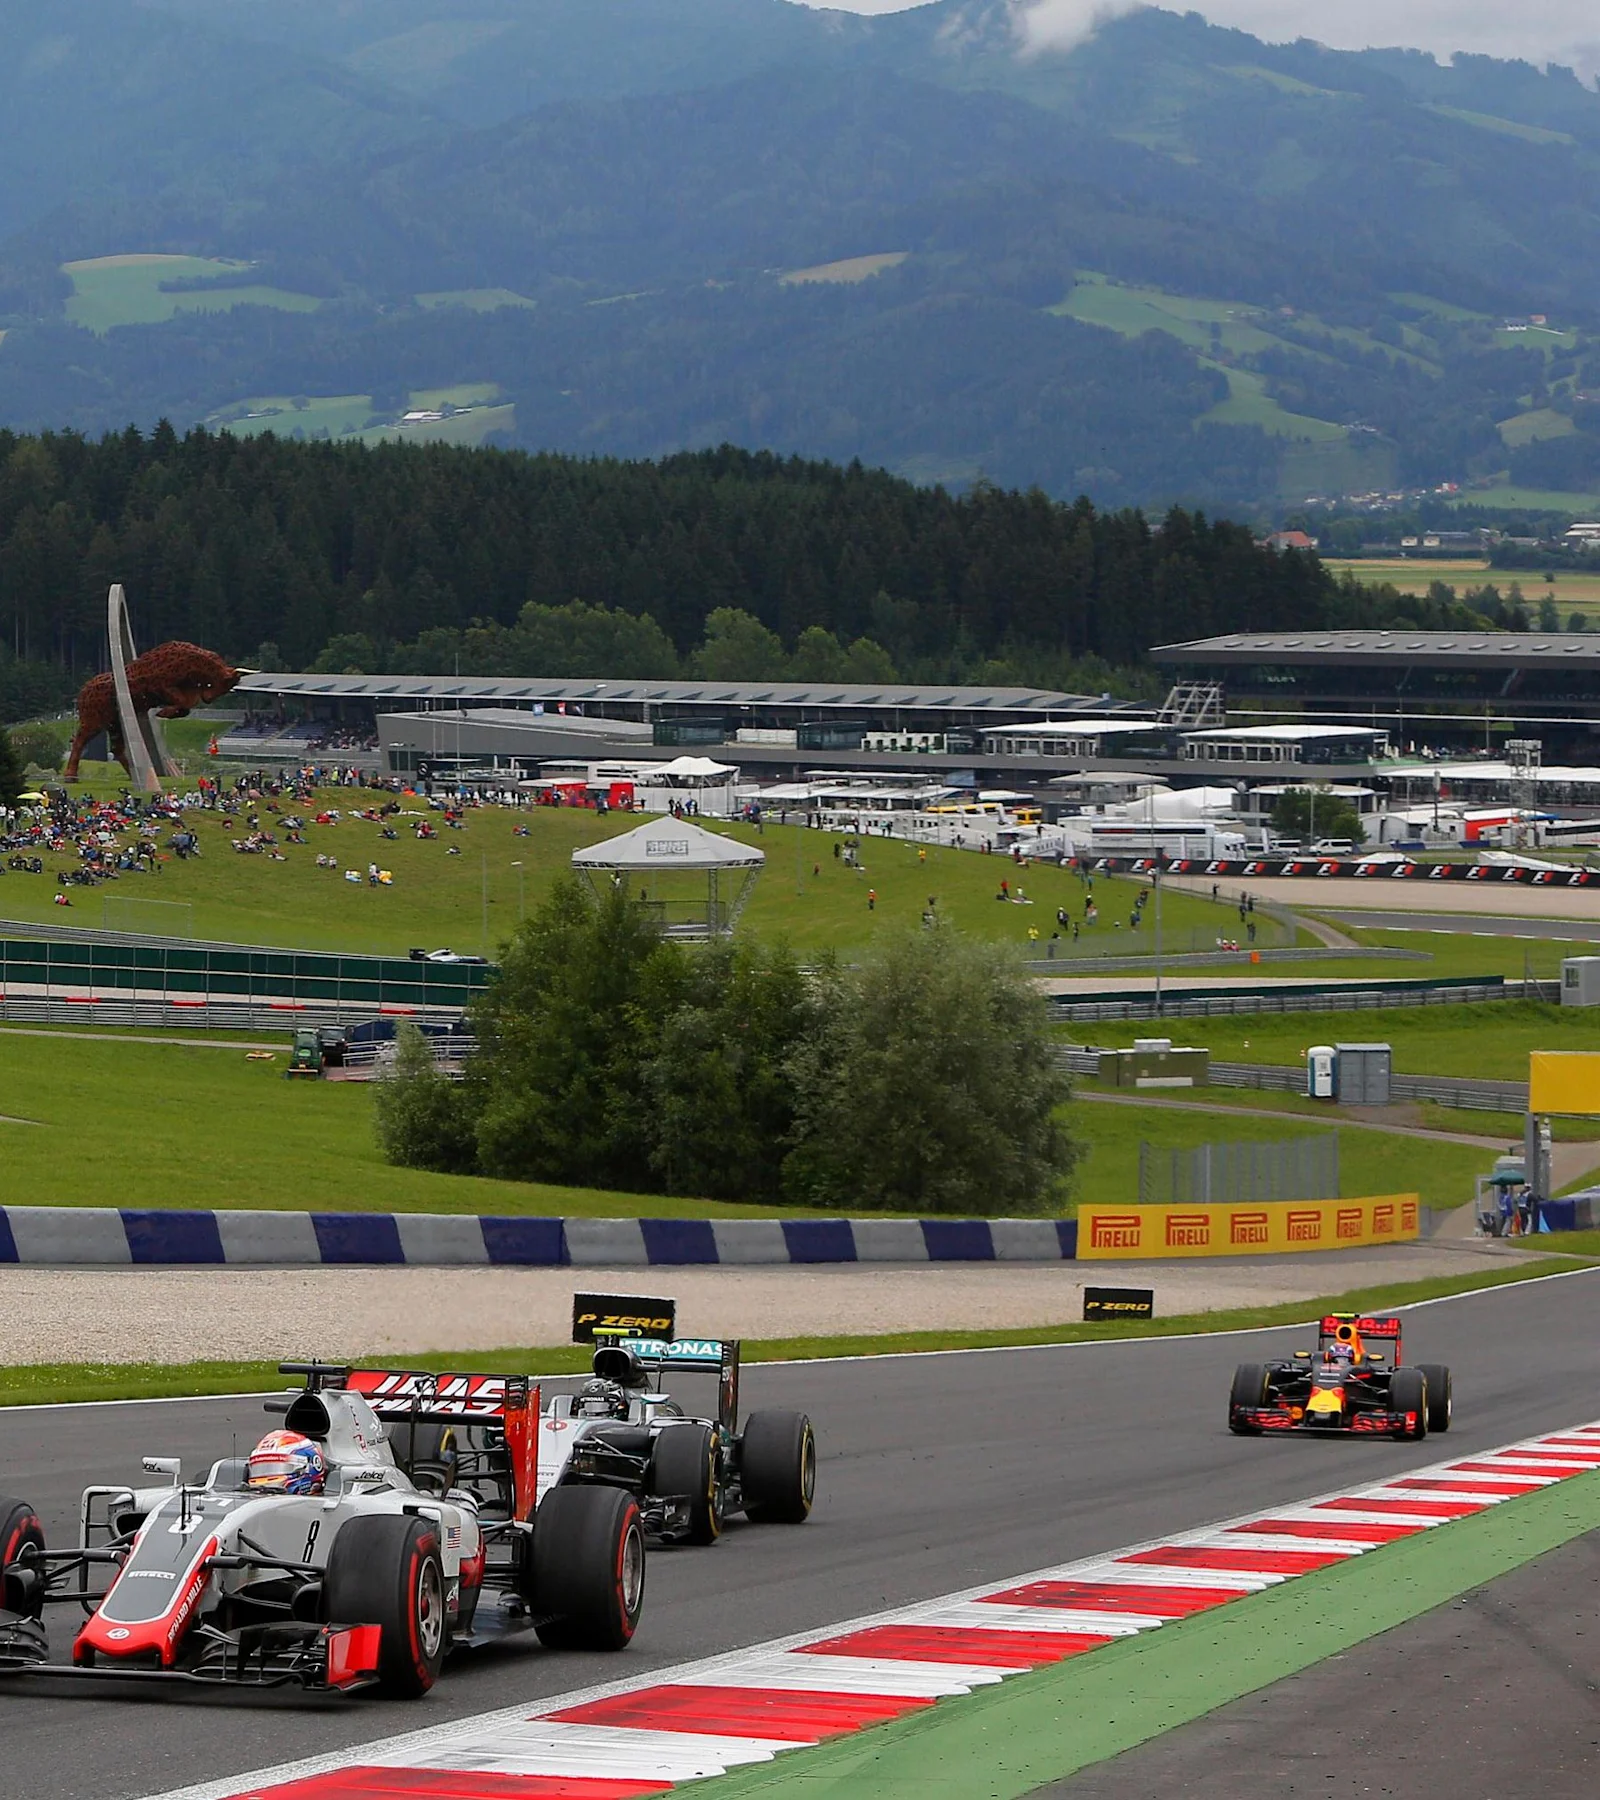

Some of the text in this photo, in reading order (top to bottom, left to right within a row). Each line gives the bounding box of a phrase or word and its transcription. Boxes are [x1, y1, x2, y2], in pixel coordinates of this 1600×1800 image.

[1091, 1215, 1141, 1248] PIRELLI
[1165, 1214, 1209, 1246] PIRELLI
[1230, 1213, 1268, 1244] PIRELLI
[1287, 1210, 1321, 1241] PIRELLI
[1337, 1208, 1362, 1239] PIRELLI
[577, 1313, 672, 1329] P ZERO
[1086, 1301, 1150, 1311] P ZERO
[168, 1514, 204, 1534] 8
[302, 1520, 321, 1563] 8
[128, 1570, 176, 1580] PIRELLI
[167, 1575, 204, 1644] RICHARD MILLE
